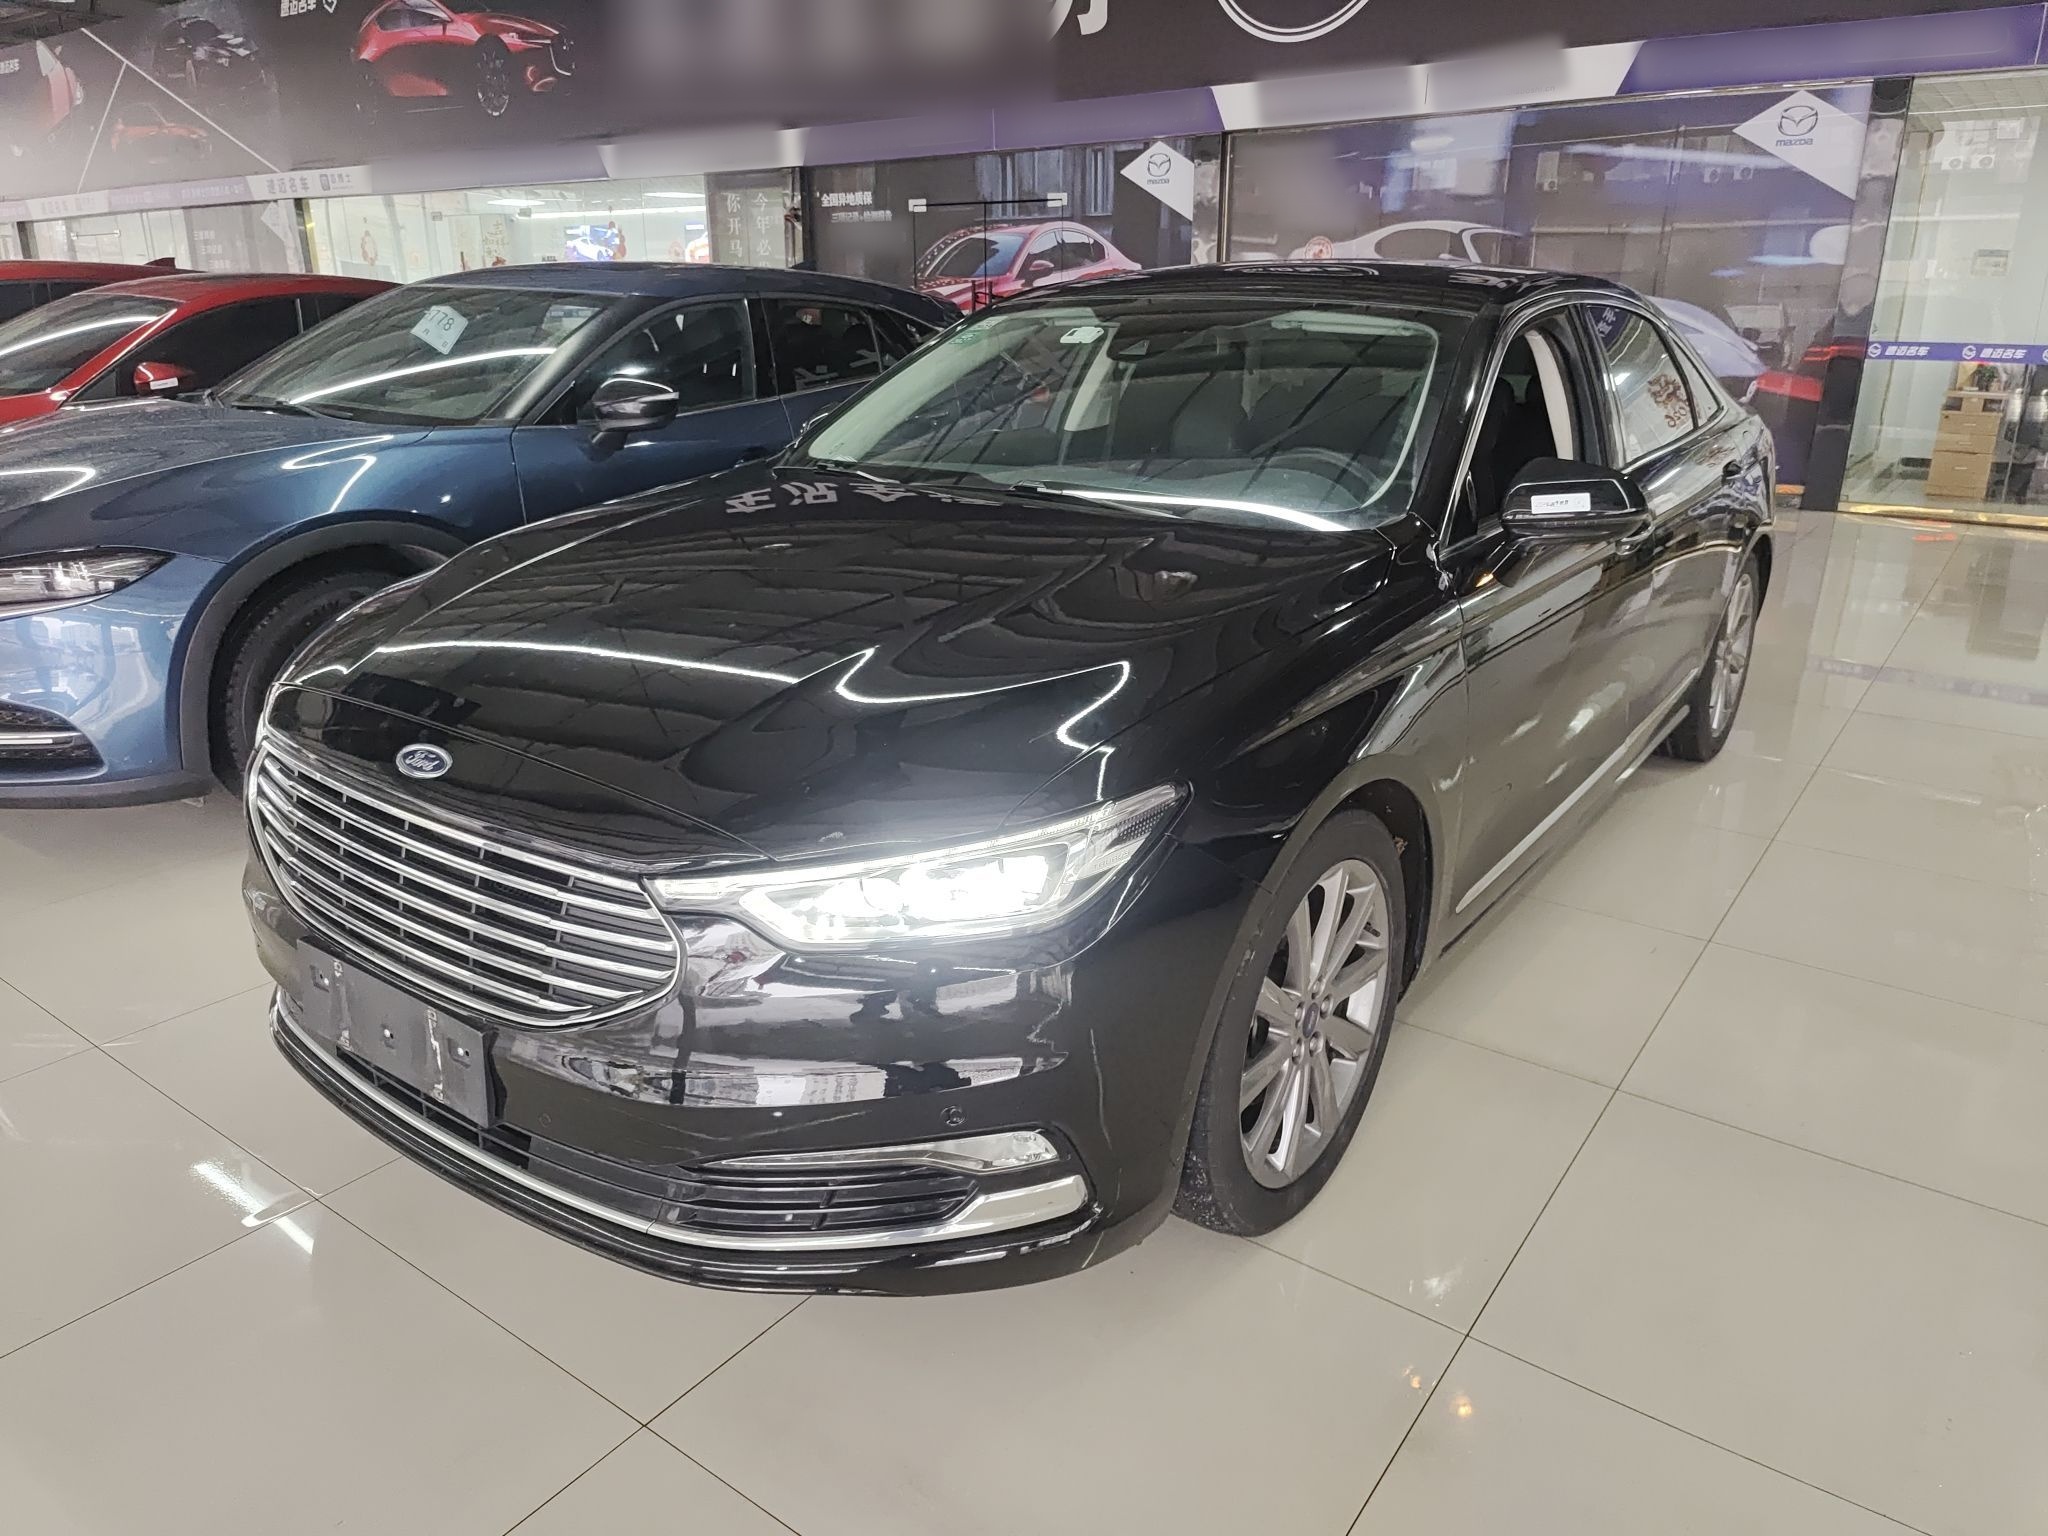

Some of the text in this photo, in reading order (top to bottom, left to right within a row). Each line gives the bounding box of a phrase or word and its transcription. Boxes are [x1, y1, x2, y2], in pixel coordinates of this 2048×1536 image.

[1776, 138, 1814, 147] mazda
[726, 194, 743, 264] 你开马
[405, 750, 441, 771] Ford
